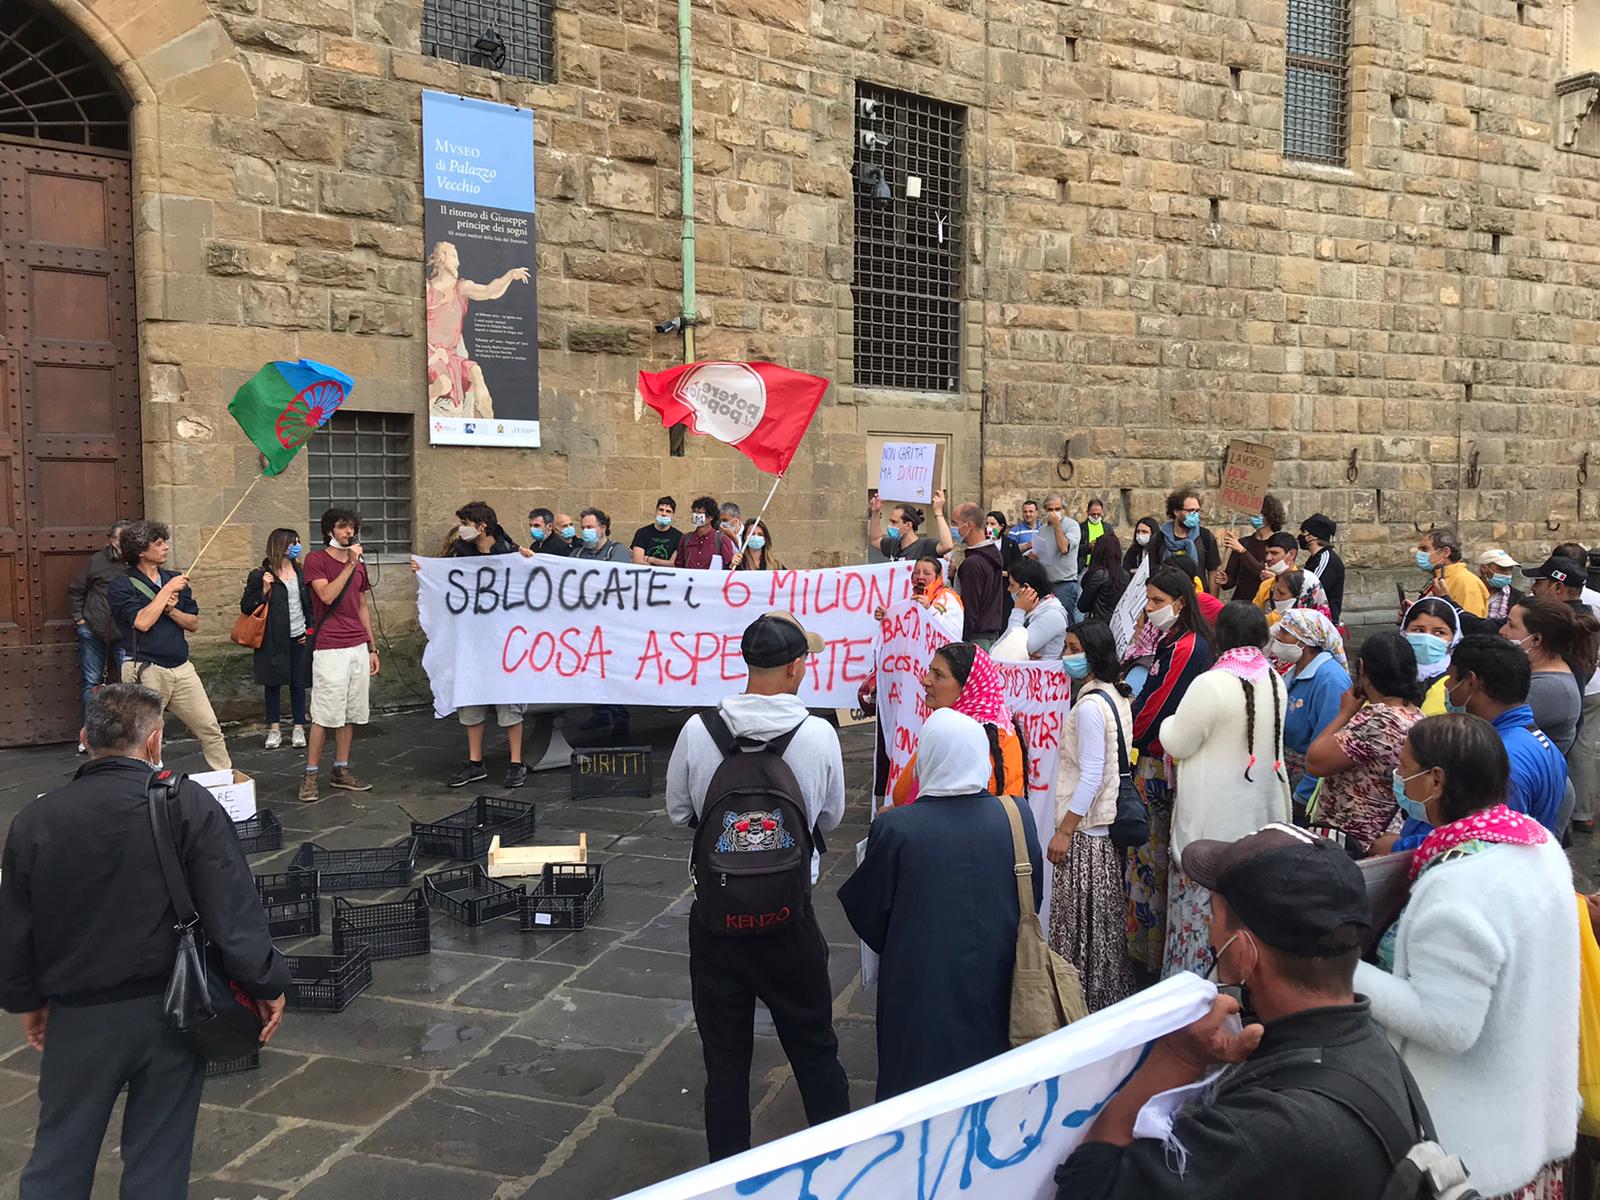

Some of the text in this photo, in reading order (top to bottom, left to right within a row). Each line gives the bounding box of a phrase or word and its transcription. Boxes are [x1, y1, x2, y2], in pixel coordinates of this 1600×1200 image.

[436, 160, 497, 184] di Palazzo
[436, 175, 480, 194] Vecchio
[440, 204, 528, 227] Il ritorno di Giuseppe
[456, 220, 528, 238] principe dei sogni
[1229, 452, 1265, 470] LAVORO
[445, 566, 676, 614] SBLOCCATE
[722, 570, 751, 608] 6
[502, 624, 612, 679] COSA
[580, 752, 646, 775] DIRITTI
[725, 906, 790, 928] KENZO
